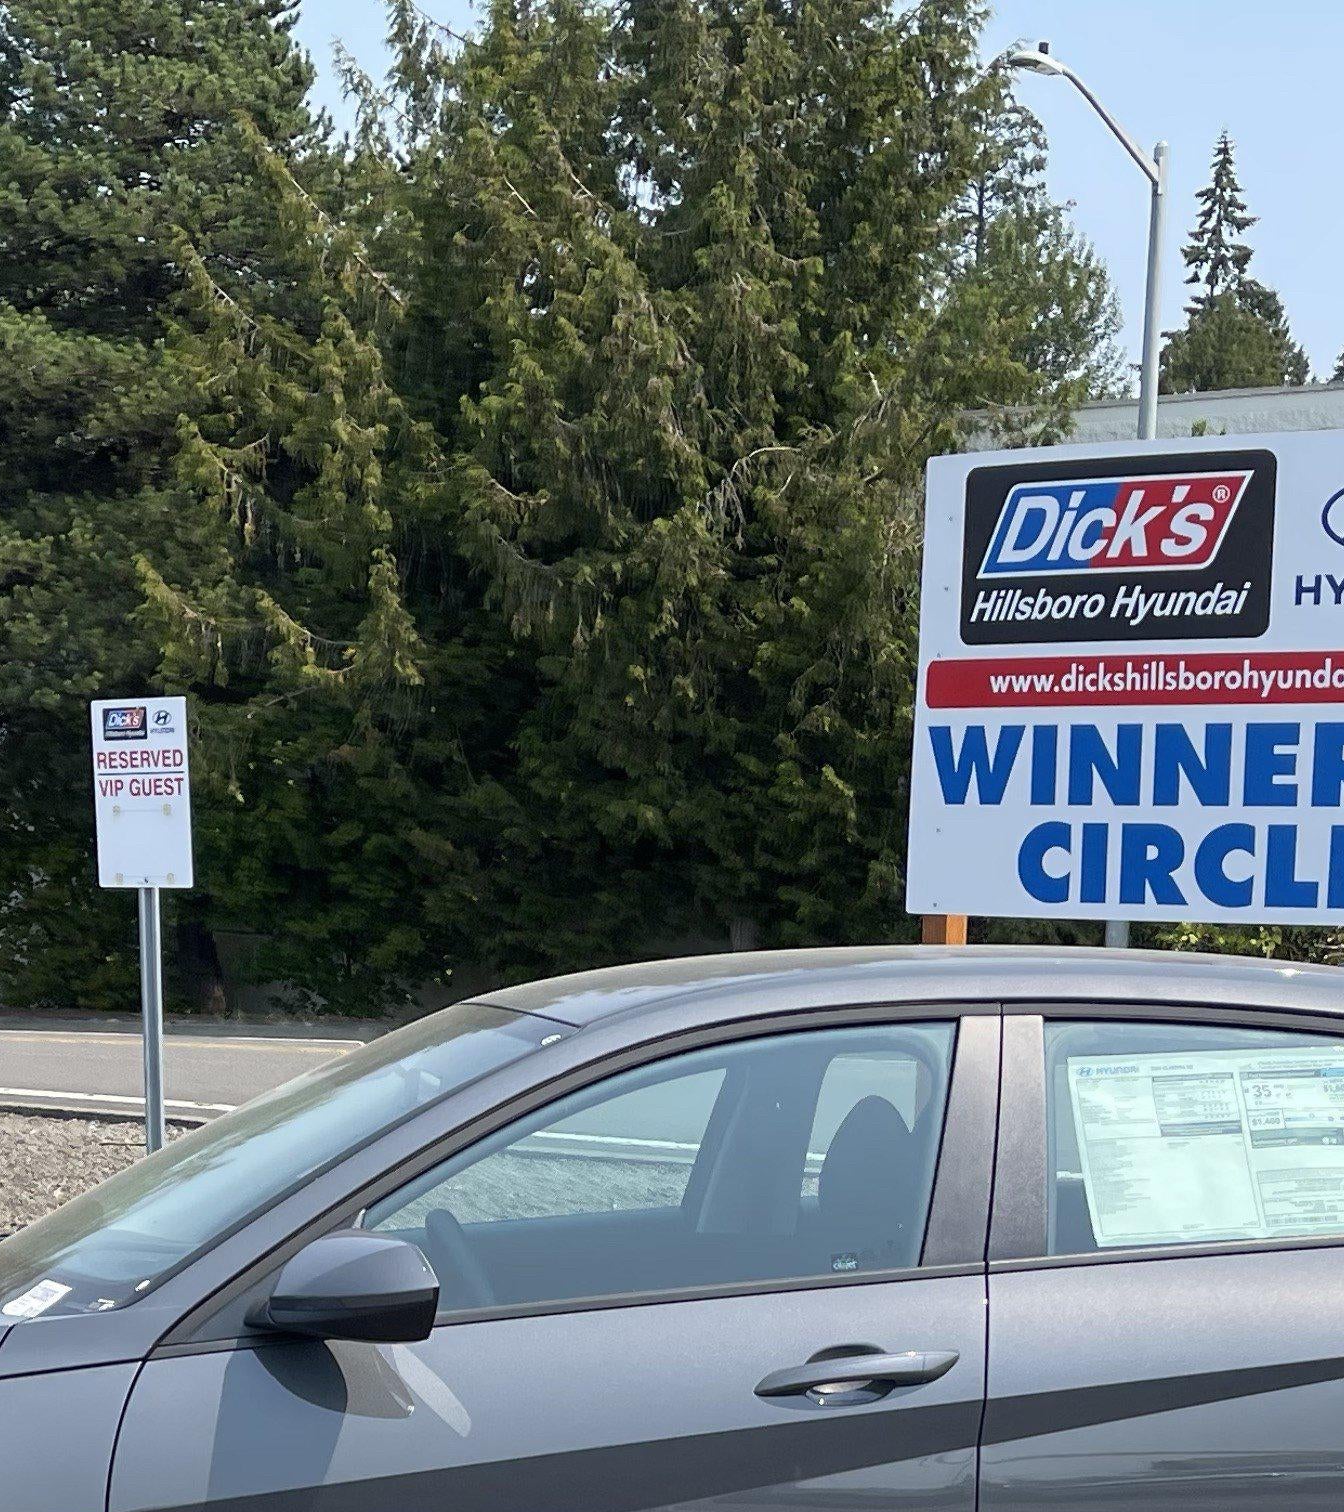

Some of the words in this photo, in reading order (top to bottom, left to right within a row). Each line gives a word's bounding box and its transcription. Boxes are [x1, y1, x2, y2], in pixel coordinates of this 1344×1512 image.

[970, 587, 1105, 622] Hillsboro
[1110, 582, 1251, 626] Hyundai
[96, 749, 184, 769] RESERVED
[98, 779, 124, 797] VIP
[129, 777, 184, 797] GUEST
